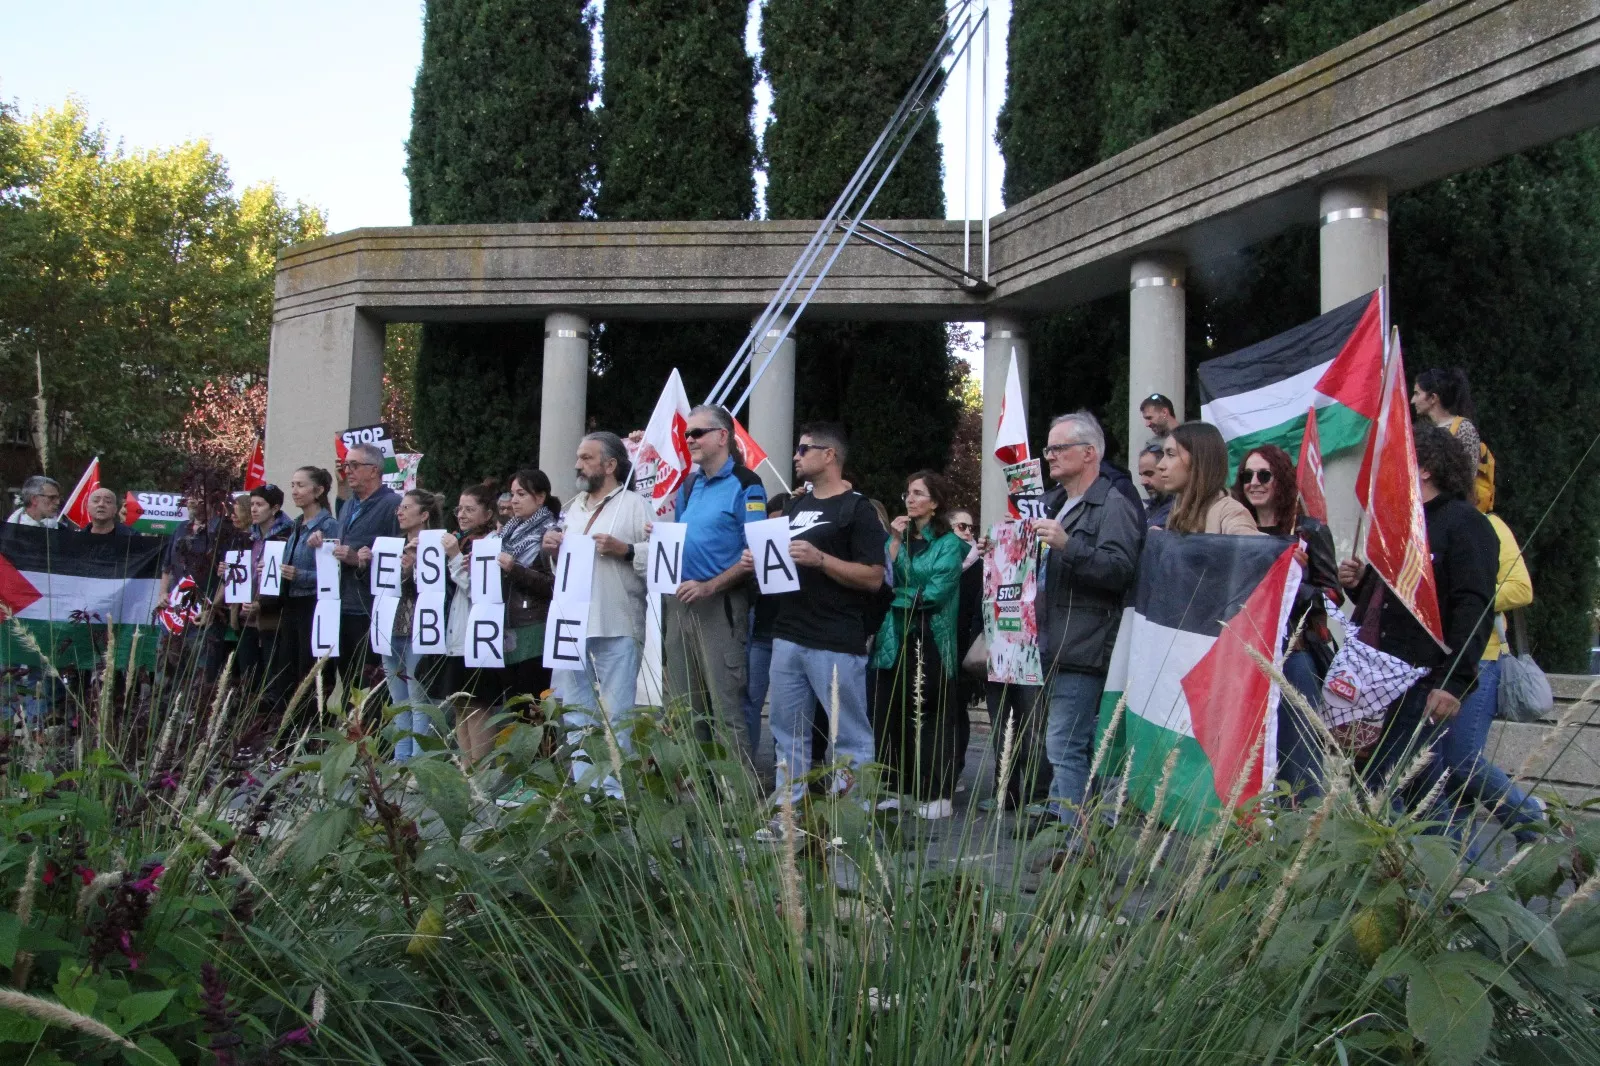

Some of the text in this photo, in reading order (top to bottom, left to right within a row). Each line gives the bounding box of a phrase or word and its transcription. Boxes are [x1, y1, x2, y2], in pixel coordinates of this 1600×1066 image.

[342, 427, 384, 448] STOP
[790, 511, 824, 527] NIKE
[998, 586, 1021, 600] STOP
